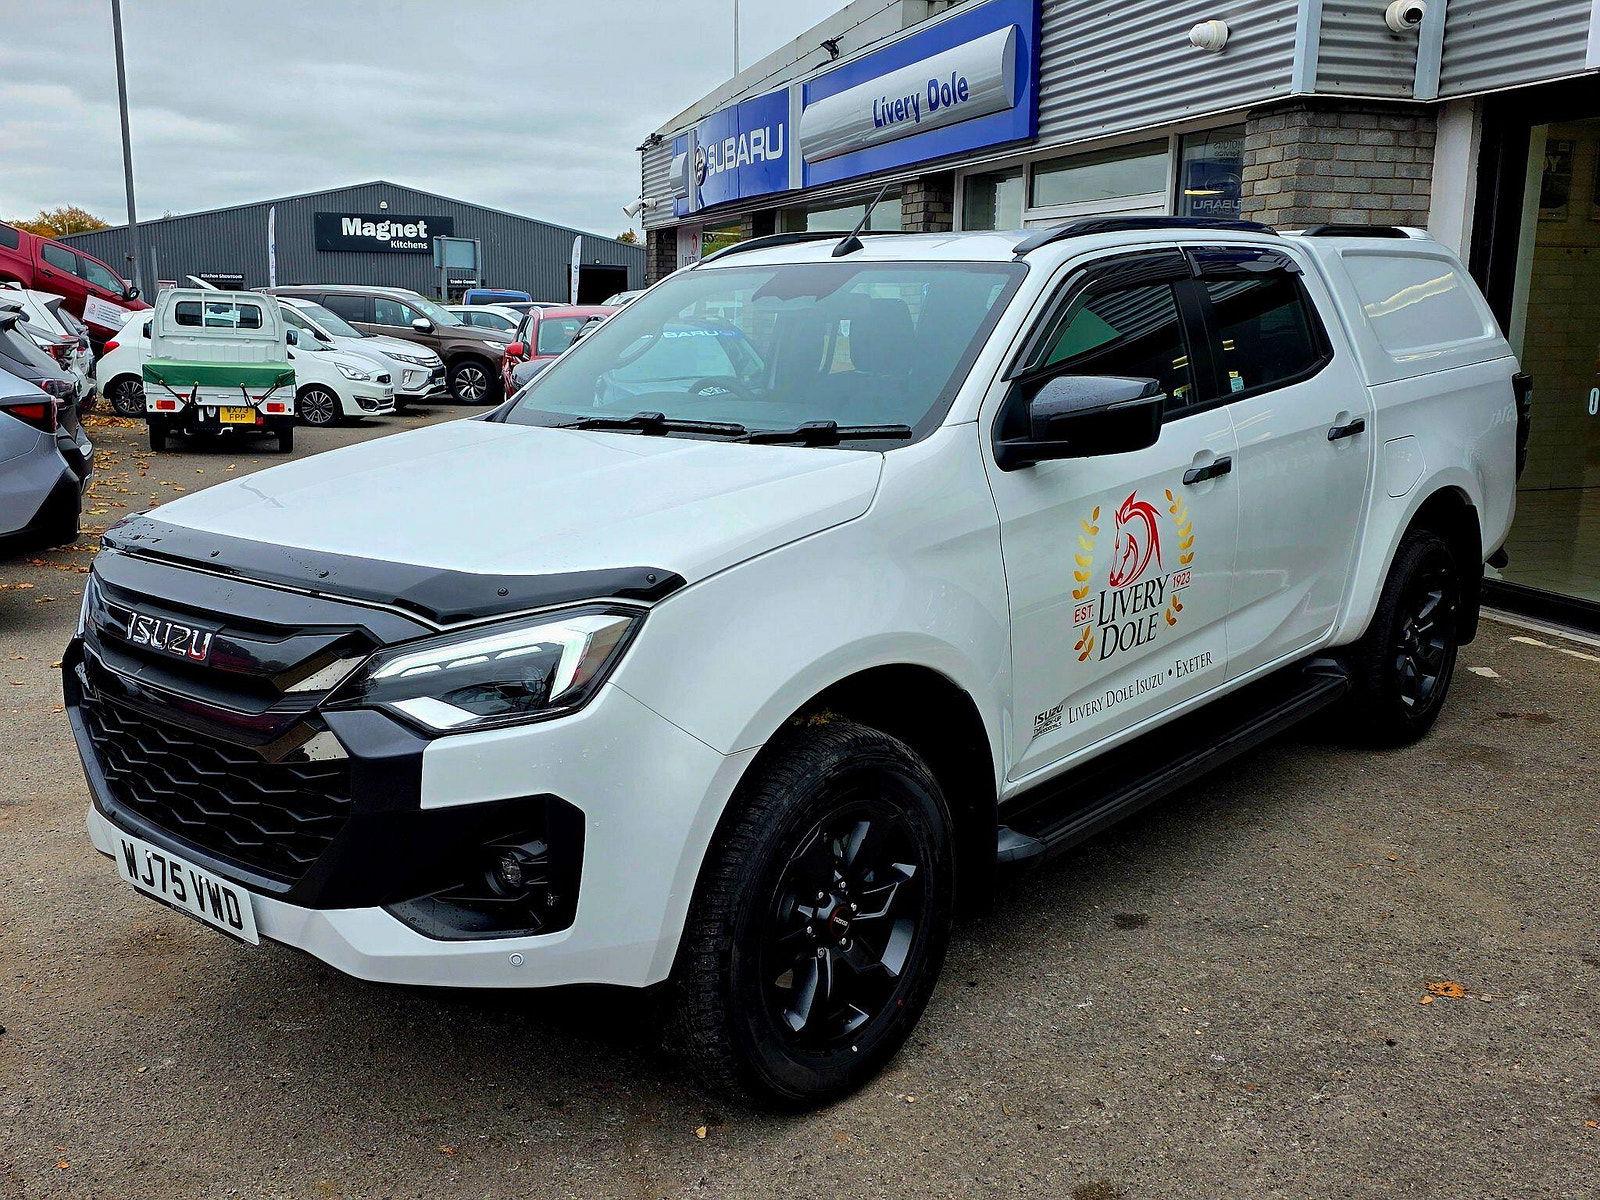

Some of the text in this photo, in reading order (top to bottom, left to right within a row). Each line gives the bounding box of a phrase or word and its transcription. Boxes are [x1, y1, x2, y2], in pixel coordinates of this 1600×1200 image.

[873, 71, 970, 128] Livery Dole
[708, 123, 783, 177] SUBARU
[341, 217, 427, 241] Magnet
[390, 240, 428, 249] Kitchens
[229, 413, 246, 421] FPP
[1097, 574, 1171, 627] LIVERY
[1172, 571, 1191, 588] 1923
[127, 612, 212, 661] ISUZU
[1074, 604, 1094, 623] EST.
[1098, 612, 1159, 661] DOLE
[1068, 652, 1213, 724] LIVERY DOLE ISUZU EXETER
[1034, 705, 1064, 726] ISUZU
[121, 839, 244, 930] WJ75 VWD
